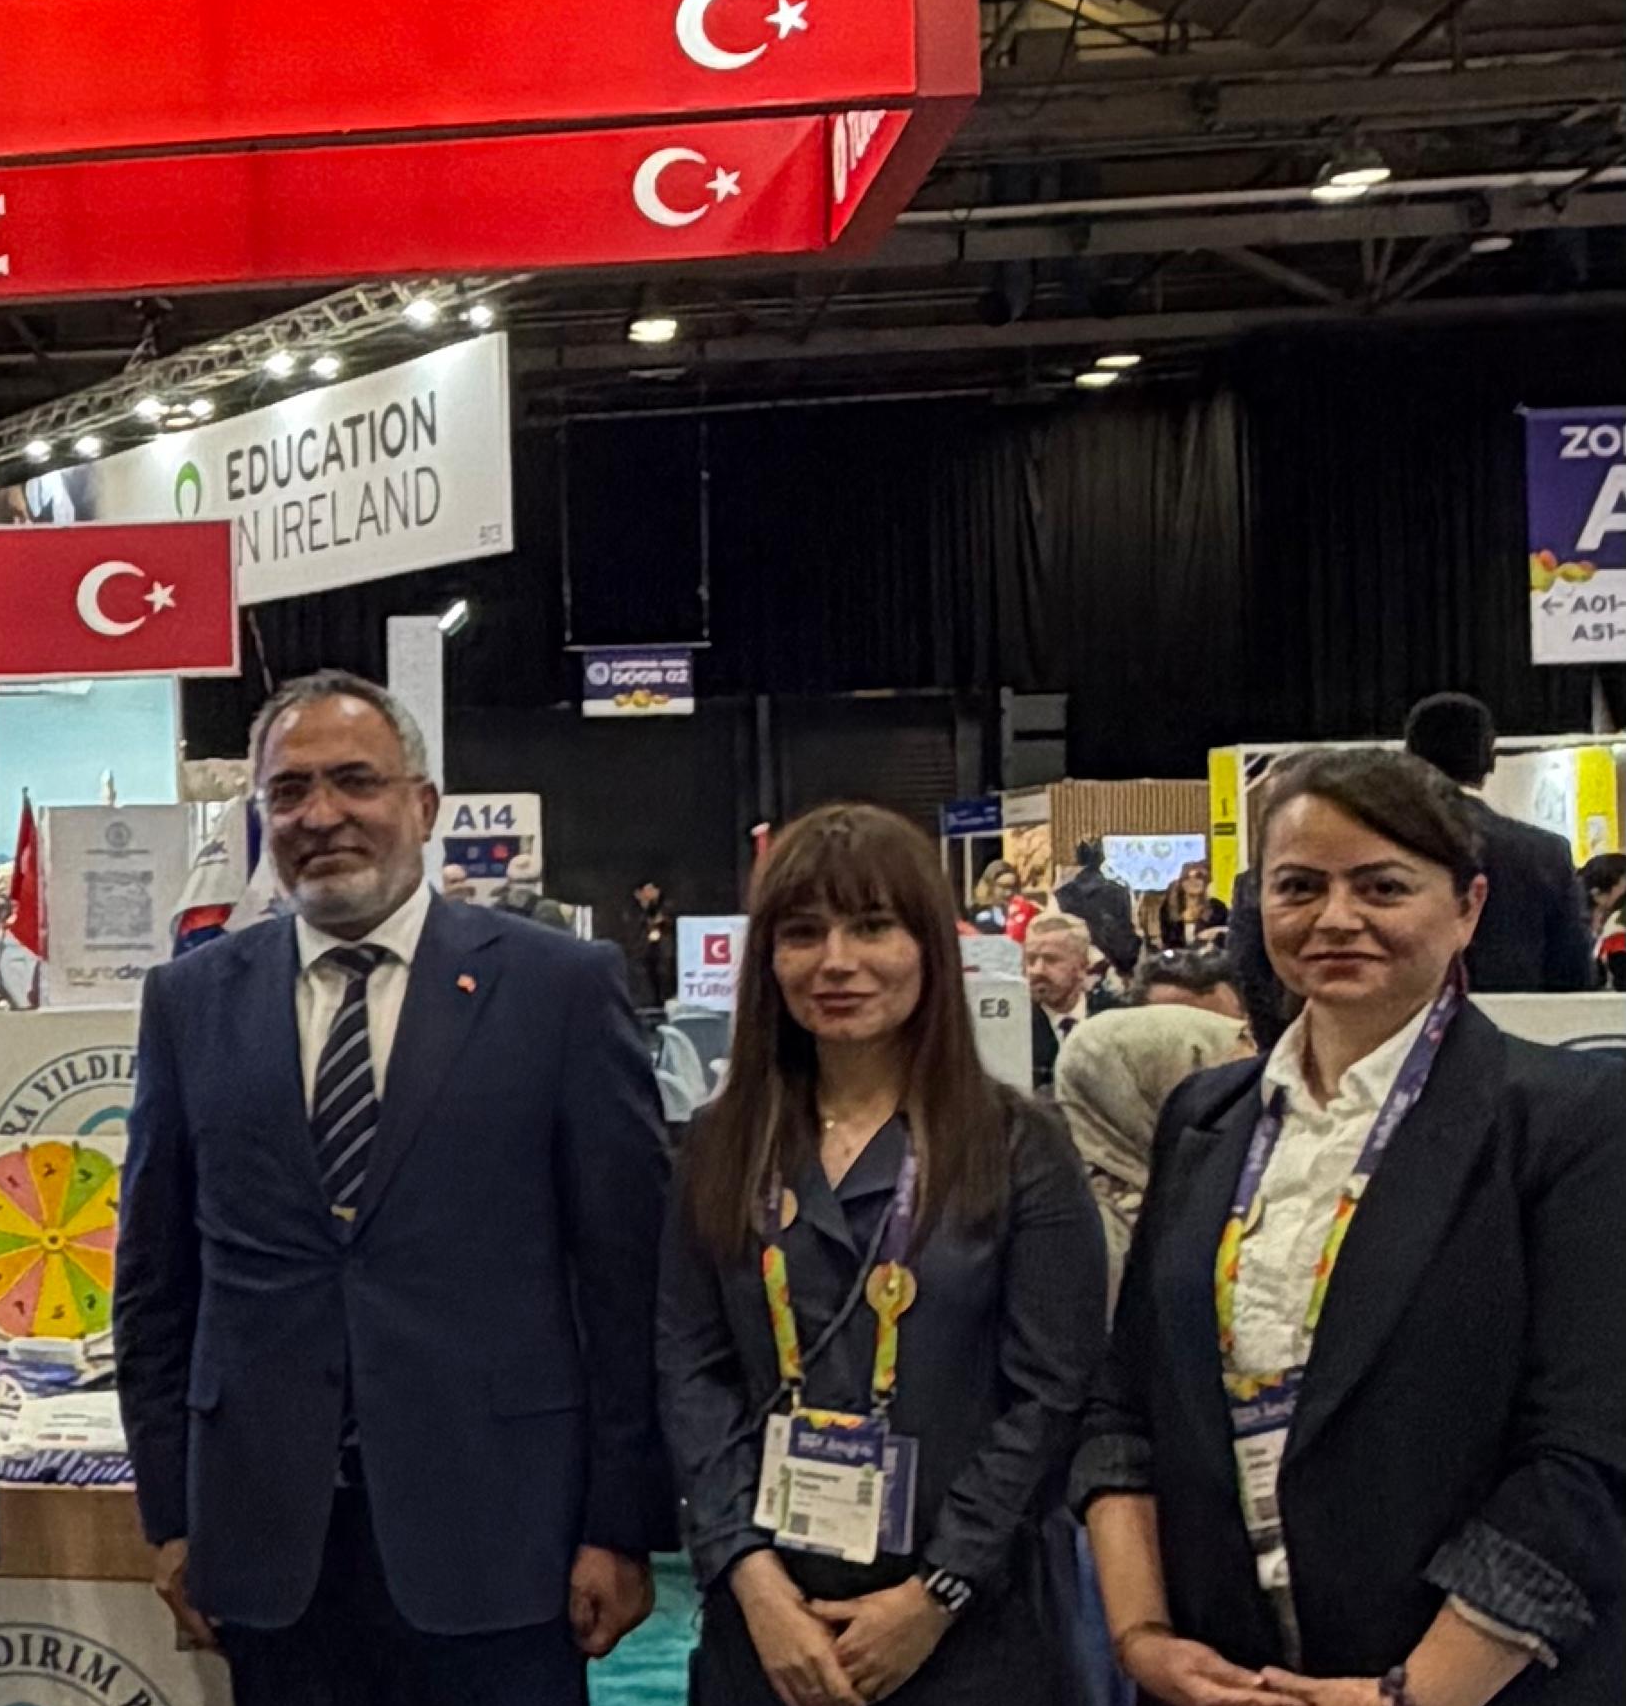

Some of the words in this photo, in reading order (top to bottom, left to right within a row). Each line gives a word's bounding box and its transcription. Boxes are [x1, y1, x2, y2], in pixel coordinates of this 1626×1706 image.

[226, 389, 437, 502] EDUCATION
[1559, 424, 1626, 459] ZO
[237, 509, 260, 567] N
[273, 465, 441, 562] IRELAND
[451, 804, 517, 831] A14
[979, 997, 1010, 1019] E8
